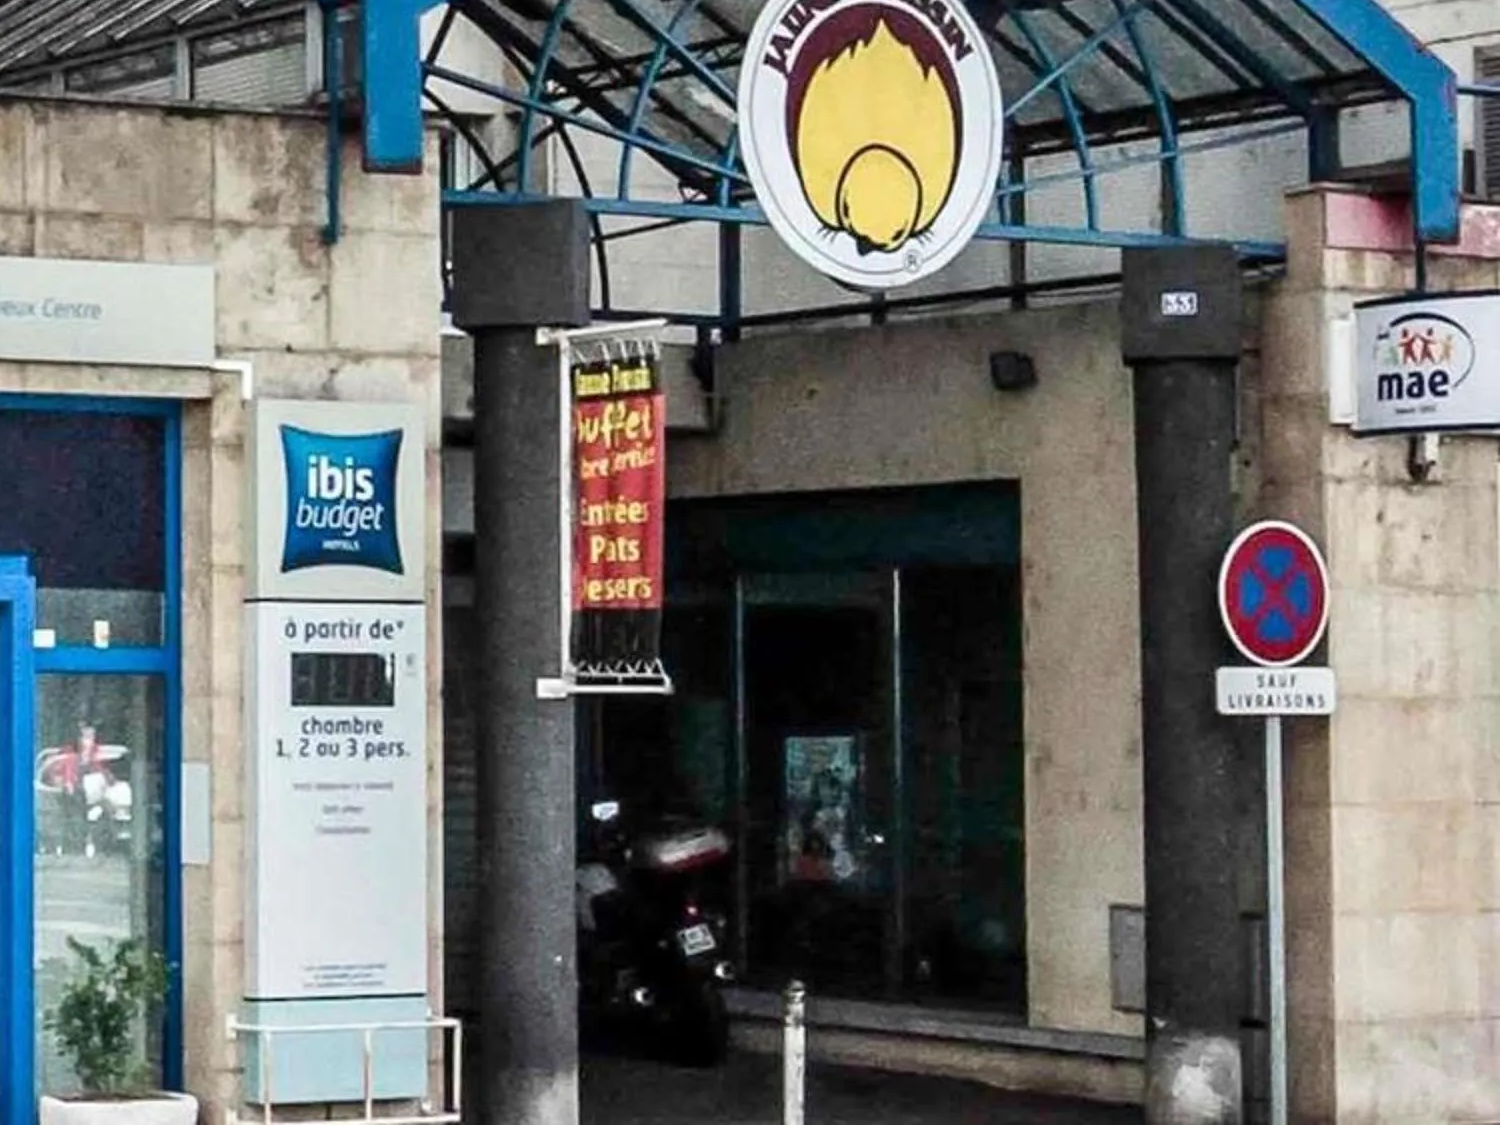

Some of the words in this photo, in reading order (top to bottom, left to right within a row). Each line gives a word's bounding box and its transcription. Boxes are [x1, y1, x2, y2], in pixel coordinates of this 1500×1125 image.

[42, 297, 103, 320] Centre
[1377, 369, 1449, 401] mae
[308, 454, 375, 501] ibis
[296, 497, 385, 536] budget
[322, 540, 360, 551] HOTELS
[304, 618, 363, 644] partir
[1257, 675, 1295, 688] SAUF
[1228, 694, 1325, 708] LIVRAISONS
[301, 715, 384, 735] chambre
[300, 738, 310, 757] 2
[347, 737, 358, 758] 3
